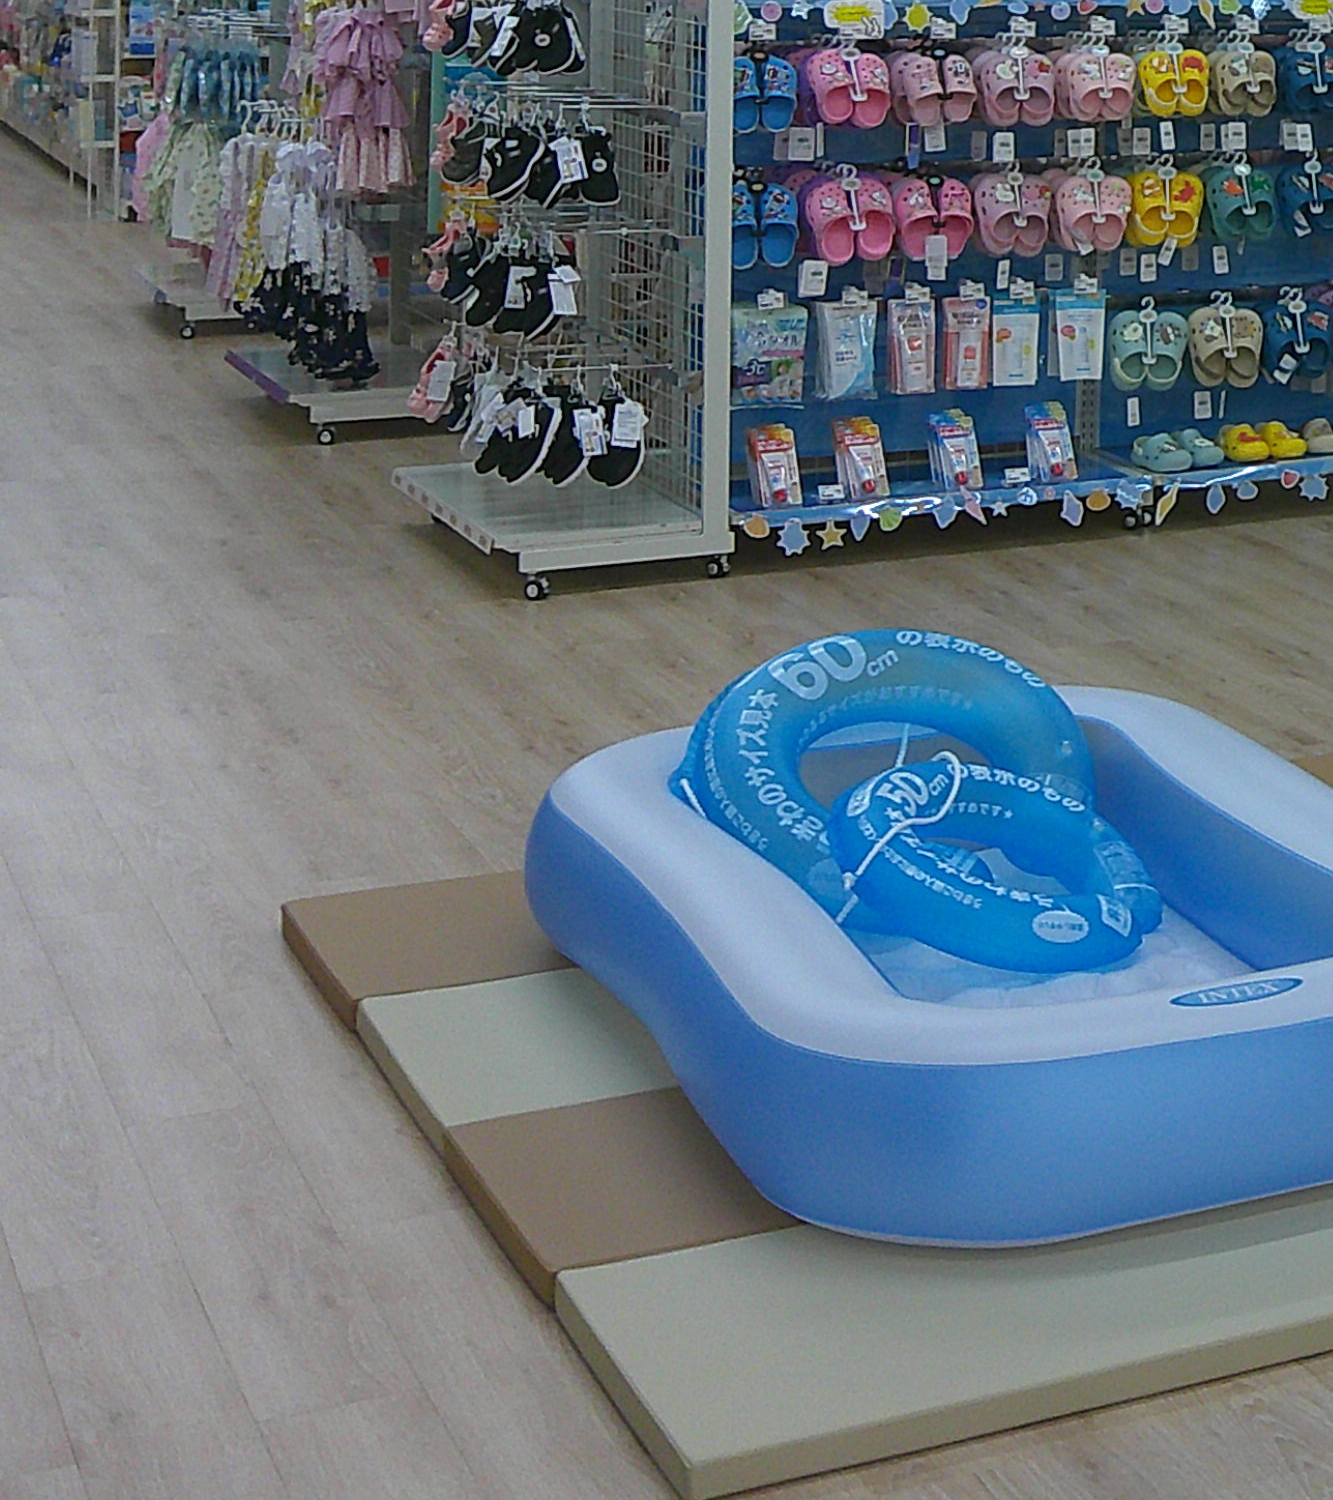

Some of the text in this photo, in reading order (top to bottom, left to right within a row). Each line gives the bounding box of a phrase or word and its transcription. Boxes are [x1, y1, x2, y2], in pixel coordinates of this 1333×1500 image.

[767, 634, 899, 700] 60cm
[896, 629, 1047, 689] の表示のもの
[1198, 982, 1280, 1004] INTEX
